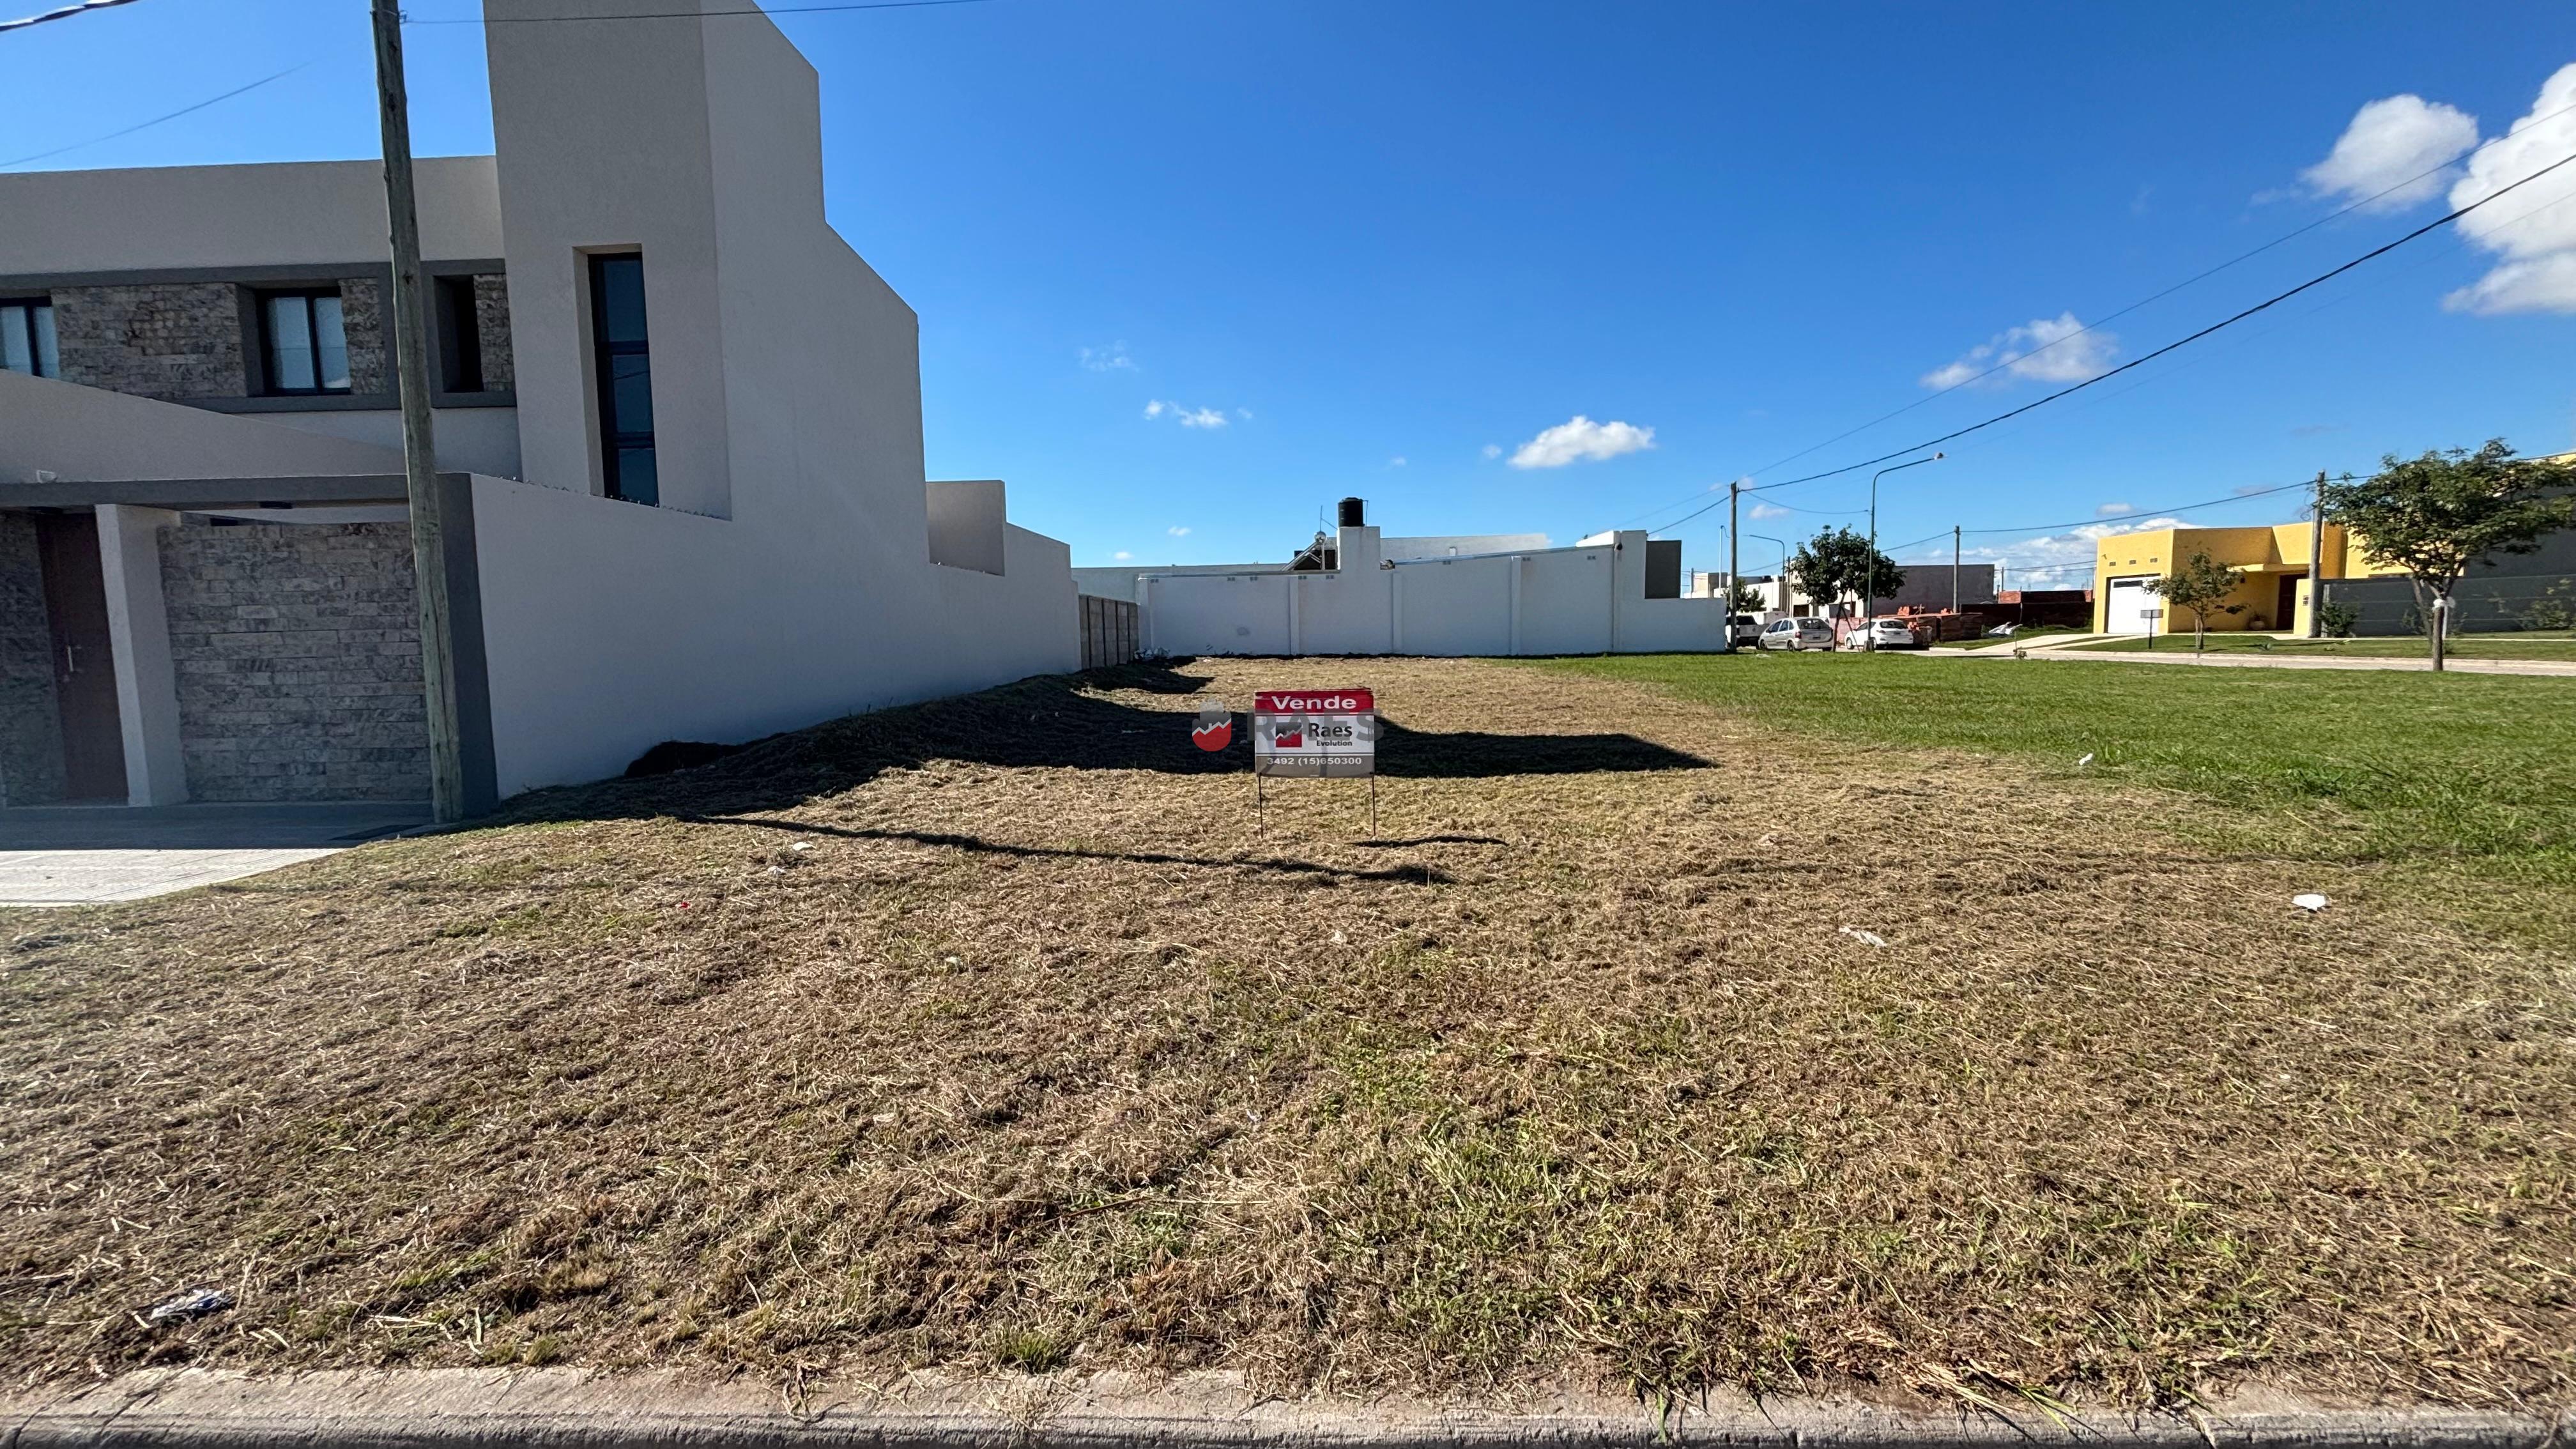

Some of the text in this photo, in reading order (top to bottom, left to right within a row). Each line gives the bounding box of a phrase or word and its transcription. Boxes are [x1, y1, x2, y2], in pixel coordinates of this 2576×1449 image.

[1272, 696, 1356, 710] Vende
[1308, 723, 1353, 737] Raes
[1298, 757, 1361, 766] (15)650300
